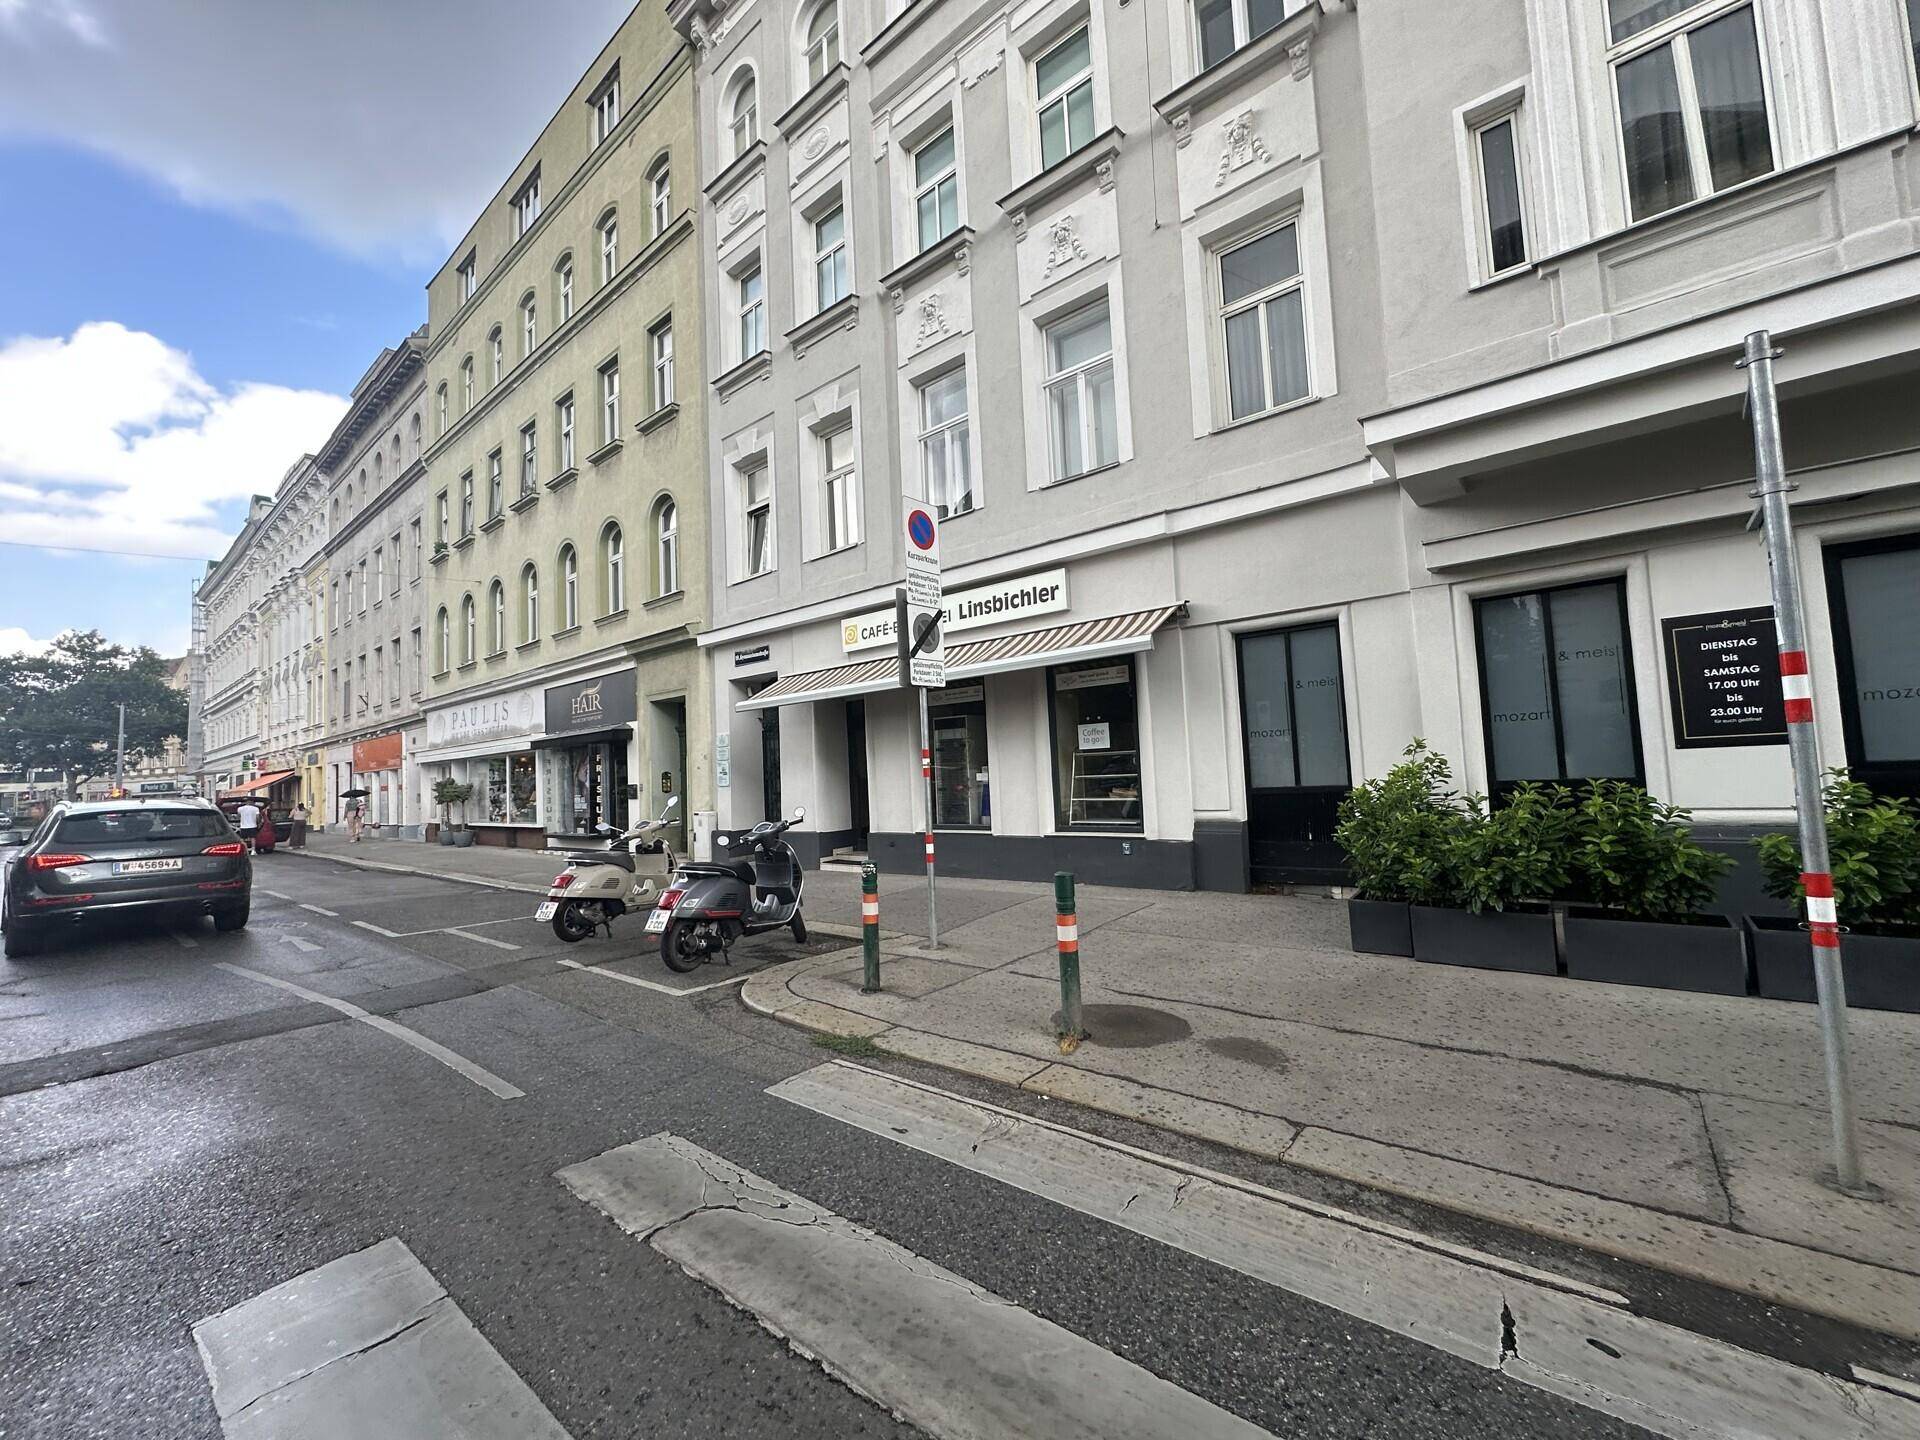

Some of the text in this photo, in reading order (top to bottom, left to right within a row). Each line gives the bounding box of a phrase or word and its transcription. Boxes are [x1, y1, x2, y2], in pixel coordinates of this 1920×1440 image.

[907, 551, 938, 565] Kurzparkzone
[958, 584, 1060, 619] Linsbichler
[1700, 637, 1758, 651] DIENSTAG
[1721, 653, 1739, 662] bis
[1703, 664, 1761, 677] SAMSTAG
[1708, 679, 1761, 690] 17.00 Uhr
[1726, 693, 1744, 702] bis
[571, 693, 603, 715] HAIR
[452, 700, 509, 730] PAULIS
[1710, 706, 1763, 717] 23.00 Uhr
[1082, 728, 1105, 737] Coffee
[1083, 736, 1100, 745] to go
[595, 754, 604, 824] FRISEUR
[122, 863, 130, 871] W
